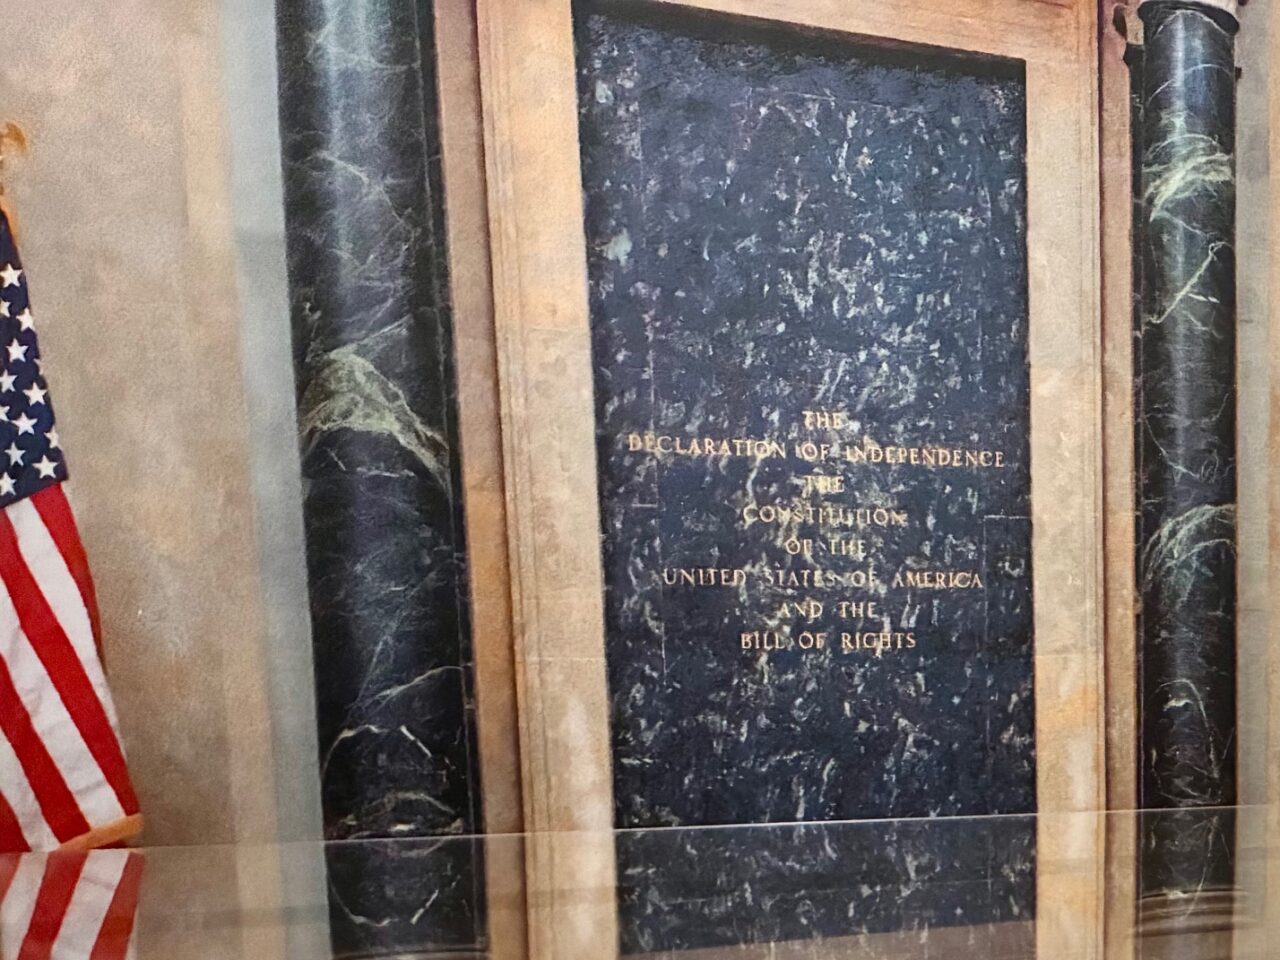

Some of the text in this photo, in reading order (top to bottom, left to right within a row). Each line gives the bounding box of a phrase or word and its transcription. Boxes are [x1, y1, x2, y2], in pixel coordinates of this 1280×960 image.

[802, 411, 844, 430] THE
[628, 432, 1005, 468] DECLARATION OF INDEPENDENCE
[803, 475, 845, 494] THE
[743, 506, 908, 527] CONSTITUTION
[785, 538, 867, 555] OF THE
[662, 568, 983, 589] UNITED STATES OF AMERICA
[780, 602, 878, 618] AND THE
[740, 632, 917, 650] BILL OF RIGHTS
